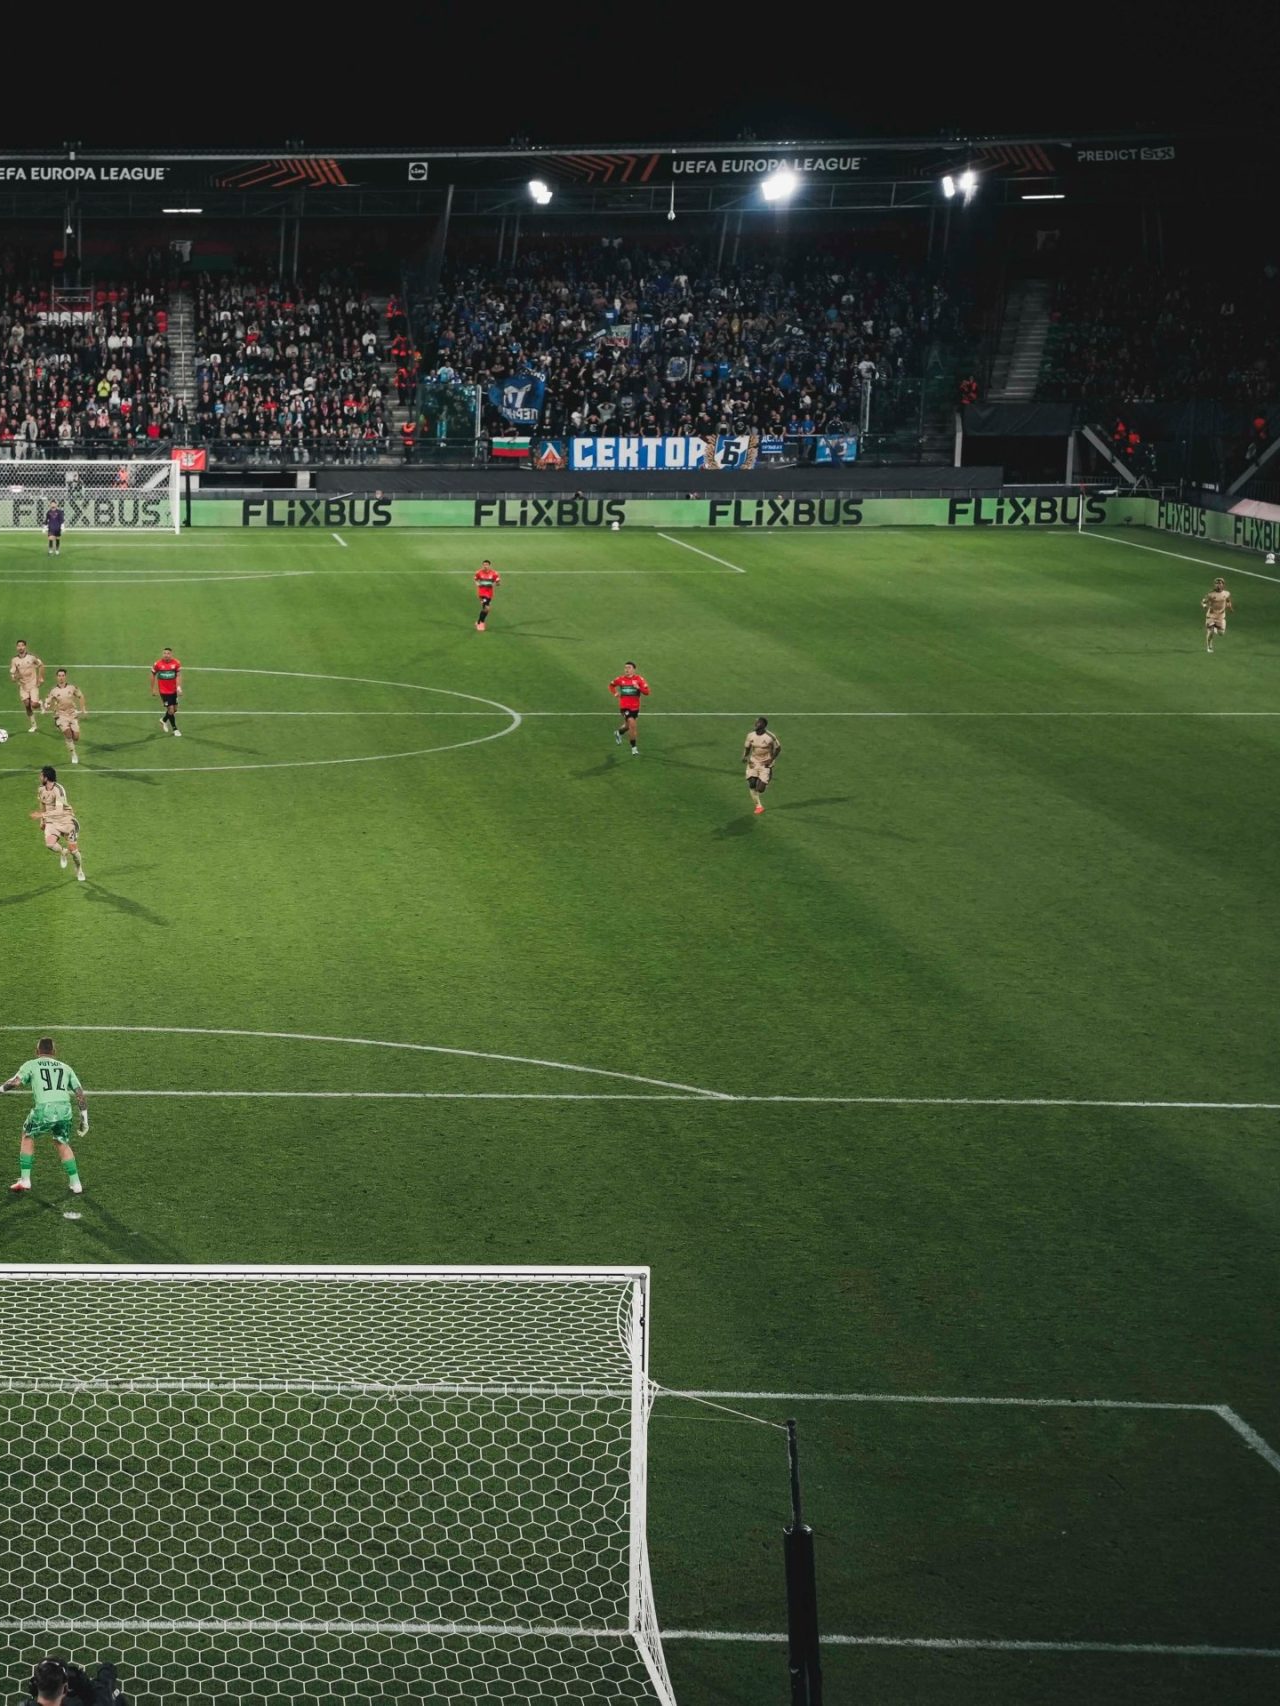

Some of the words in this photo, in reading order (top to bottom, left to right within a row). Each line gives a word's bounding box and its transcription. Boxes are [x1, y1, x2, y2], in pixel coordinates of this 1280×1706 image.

[1077, 148, 1138, 162] PREDICT
[672, 160, 717, 173] UEFA
[721, 158, 787, 172] EUROPA
[793, 157, 861, 171] LEAGUE
[31, 167, 96, 180] EUROPA
[100, 167, 165, 180] LEAGUE
[573, 437, 707, 468] СЕКТОР
[40, 1068, 65, 1091] 92
